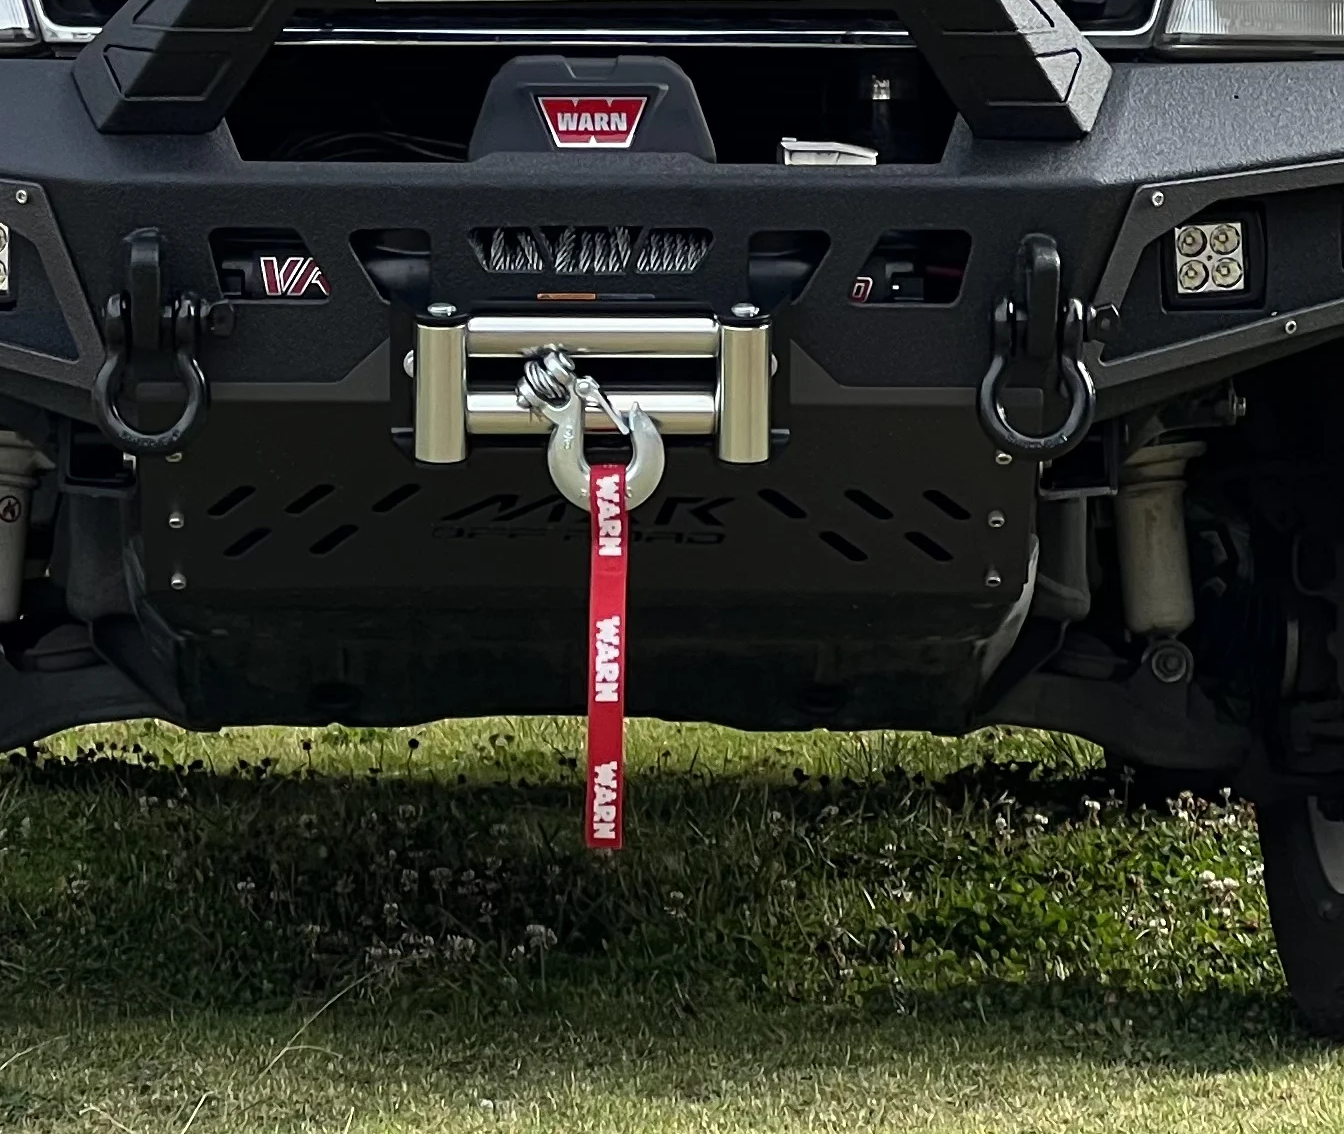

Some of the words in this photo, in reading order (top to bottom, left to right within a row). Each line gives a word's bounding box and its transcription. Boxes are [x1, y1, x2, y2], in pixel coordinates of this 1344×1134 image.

[557, 112, 628, 132] WARN
[562, 530, 727, 546] RAD
[595, 473, 622, 556] WARN
[594, 615, 621, 703] WARN
[592, 760, 618, 840] WARN
